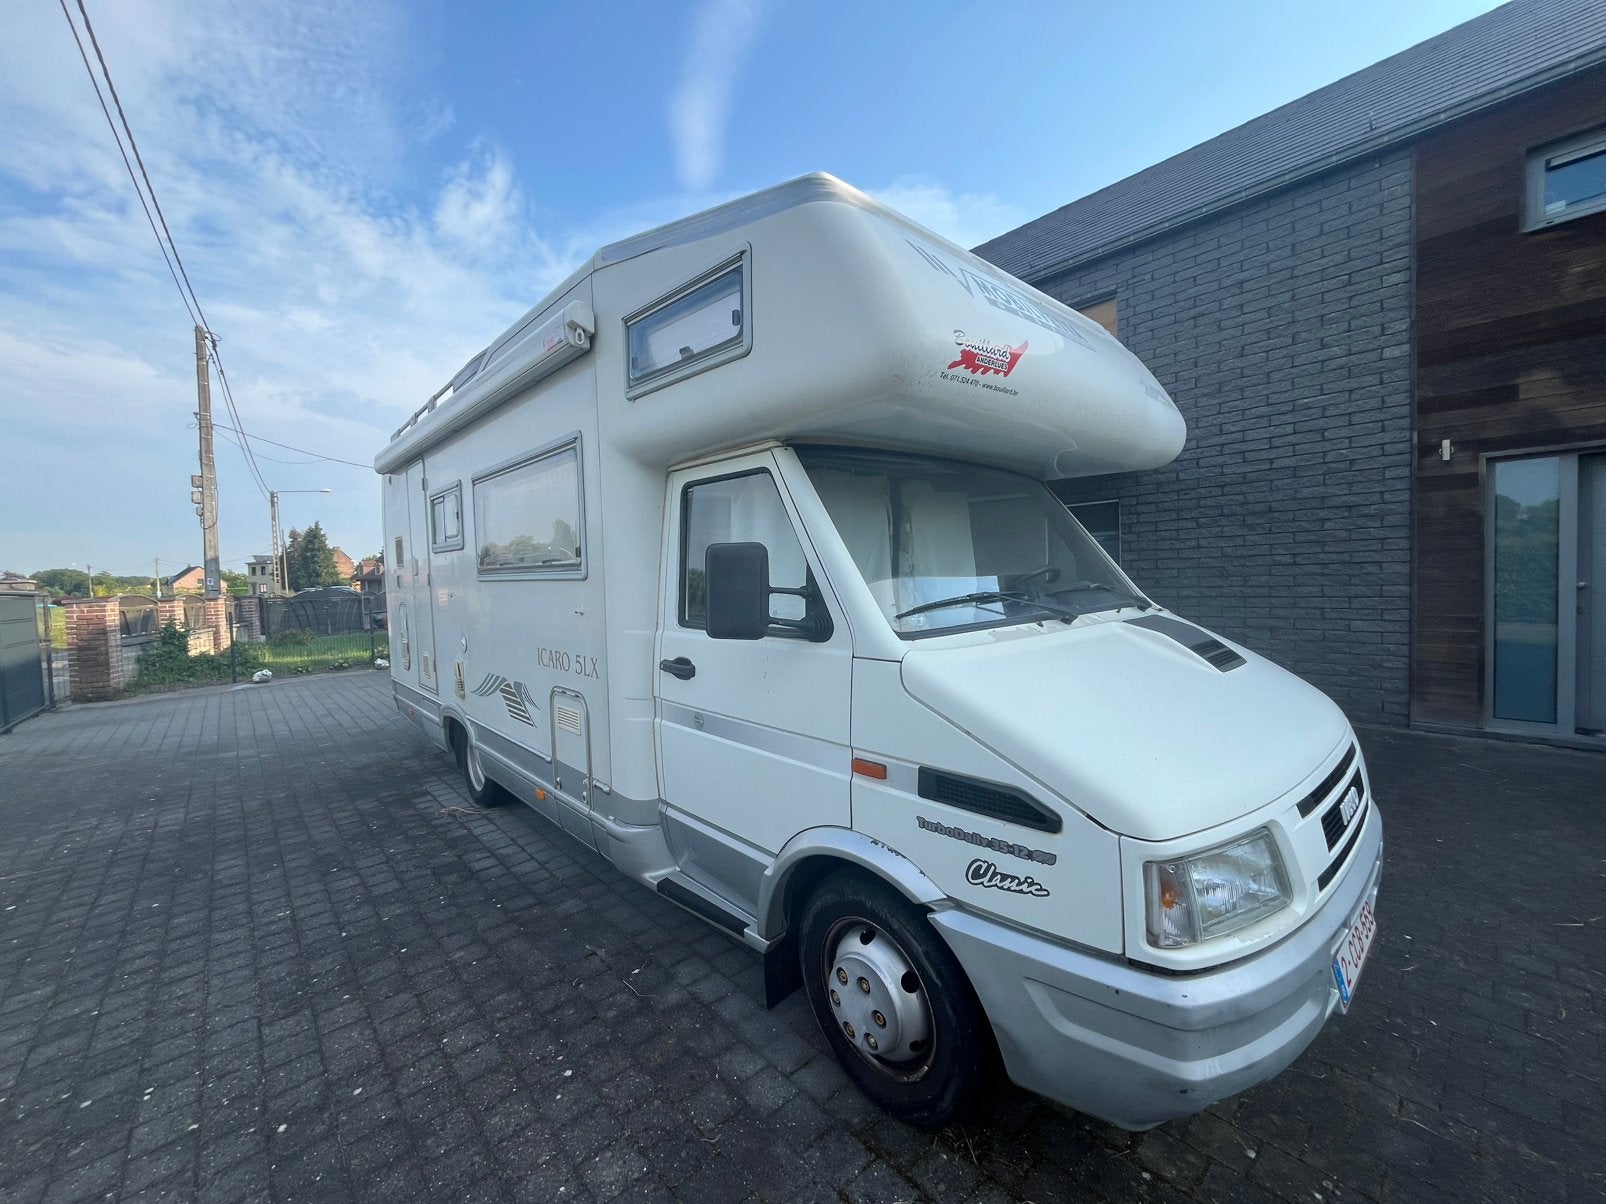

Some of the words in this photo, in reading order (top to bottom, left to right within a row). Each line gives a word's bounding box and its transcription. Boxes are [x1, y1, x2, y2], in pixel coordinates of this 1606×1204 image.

[977, 356, 1009, 371] ANDERLUES
[537, 647, 571, 672] ICARO
[575, 654, 599, 679] 5LX
[916, 815, 989, 848] TurboDaily
[965, 858, 1051, 897] Classic
